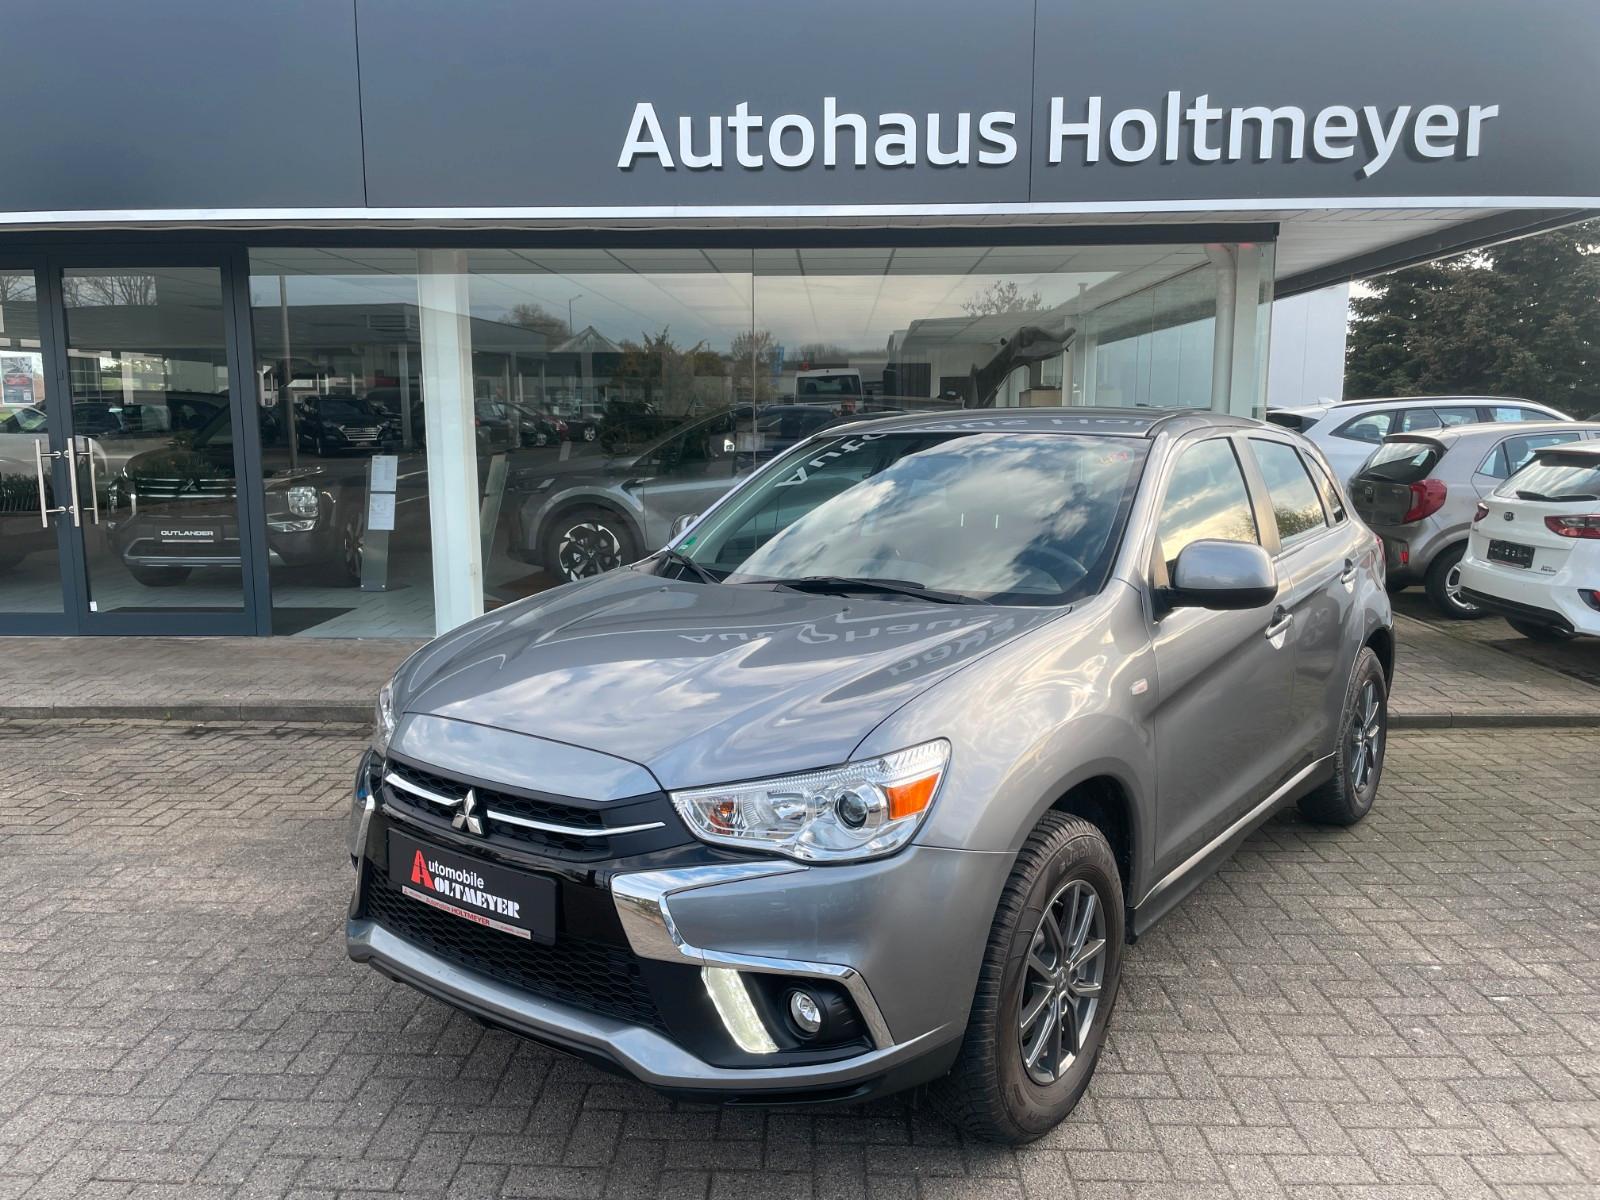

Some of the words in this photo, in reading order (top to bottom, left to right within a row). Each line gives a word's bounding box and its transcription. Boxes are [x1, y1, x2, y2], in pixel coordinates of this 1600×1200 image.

[617, 96, 1018, 169] Autohaus
[1049, 90, 1500, 178] Holtmeyer
[411, 848, 485, 891] Automobile
[451, 907, 490, 926] HOLTMEYER
